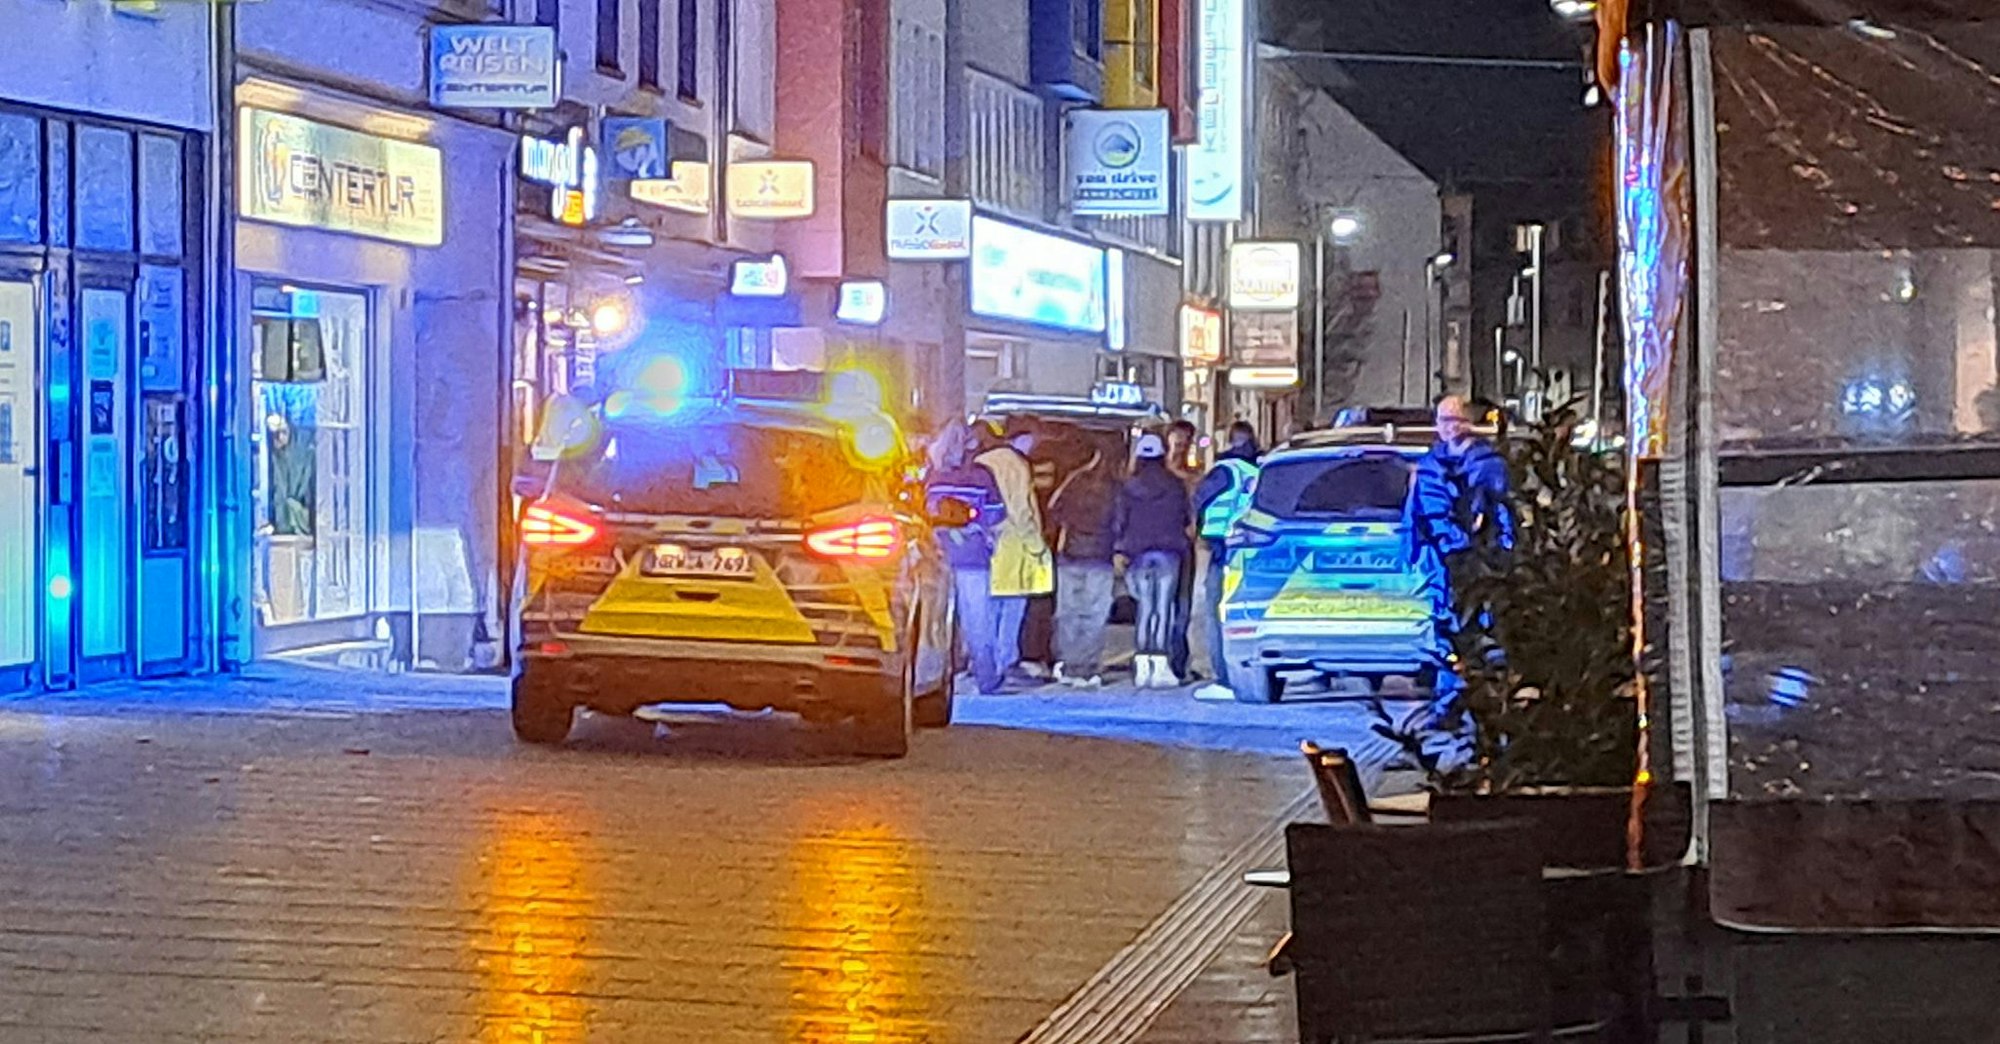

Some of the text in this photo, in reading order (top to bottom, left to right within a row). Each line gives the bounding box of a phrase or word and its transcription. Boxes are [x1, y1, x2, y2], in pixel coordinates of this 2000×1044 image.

[450, 35, 534, 55] WELT
[439, 54, 547, 75] REISEN
[290, 153, 416, 218] CENTERTUR
